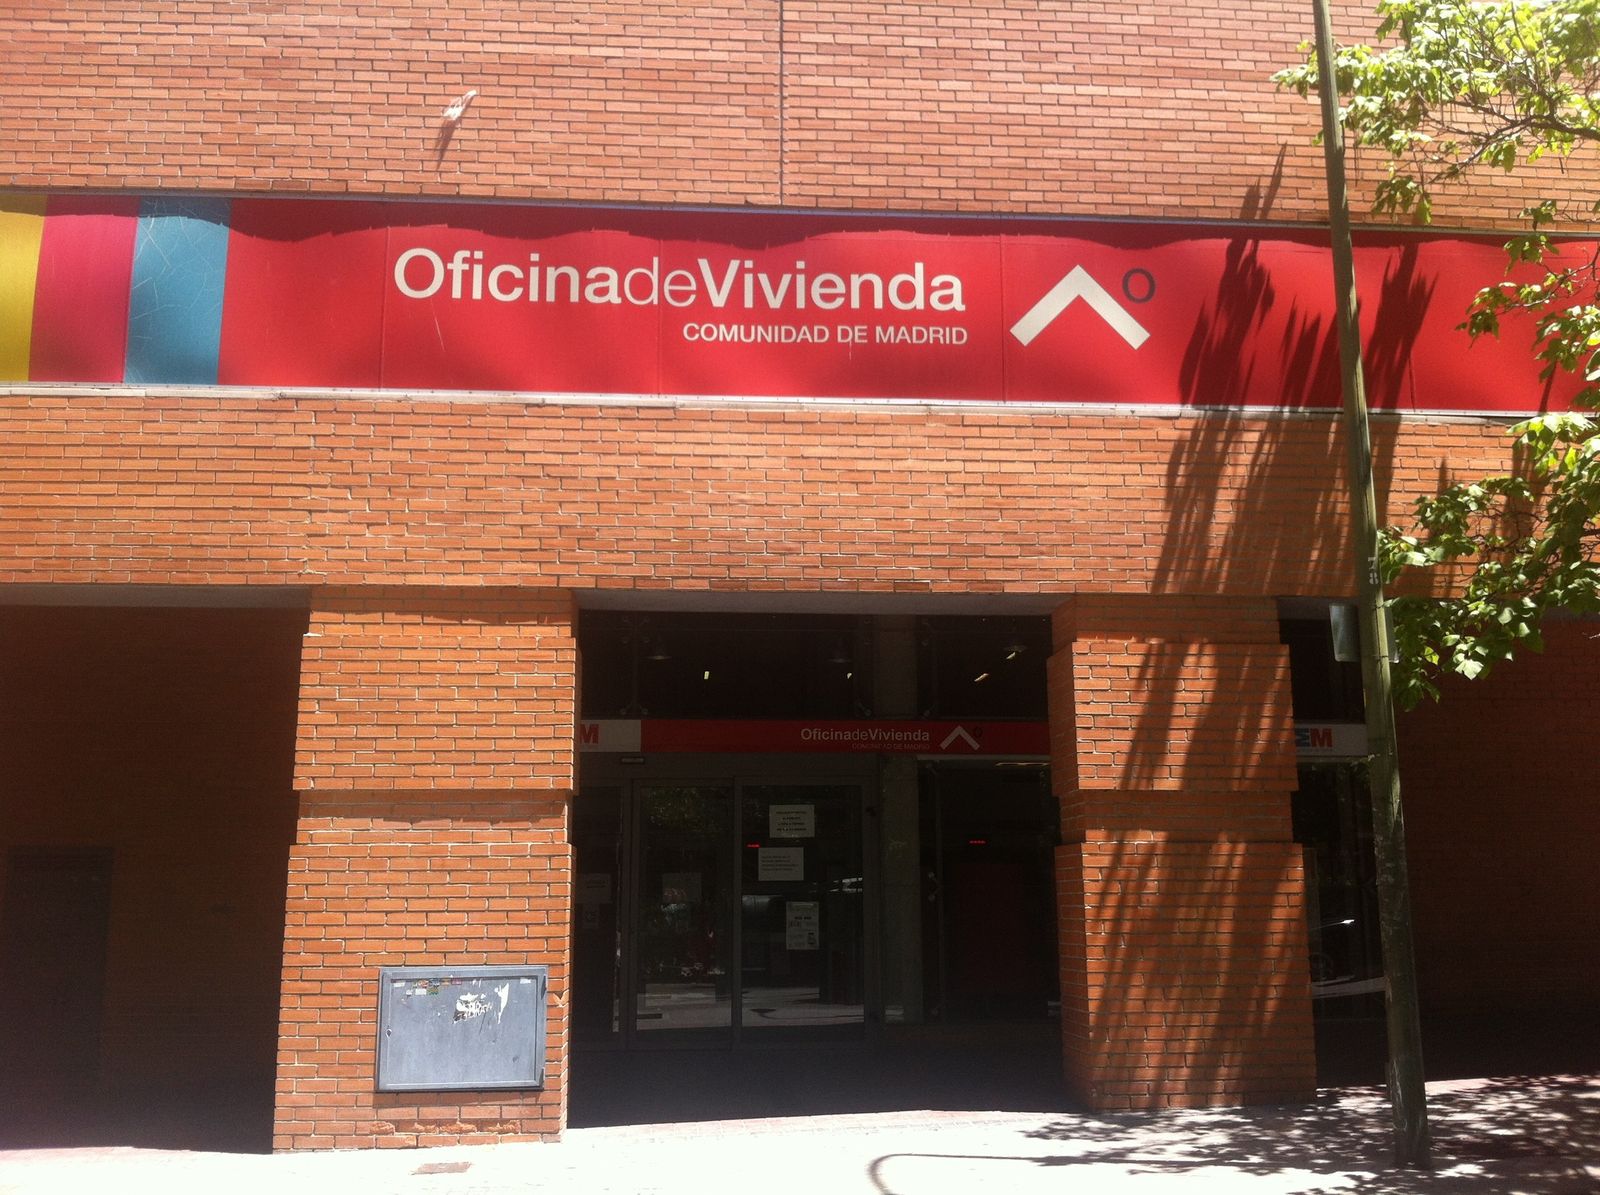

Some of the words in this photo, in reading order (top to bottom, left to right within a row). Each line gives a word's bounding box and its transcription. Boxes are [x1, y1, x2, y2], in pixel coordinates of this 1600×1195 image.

[394, 248, 966, 312] OficinadeVivienda
[682, 322, 830, 344] COMUNIDAD
[836, 324, 869, 345] DE
[875, 325, 968, 346] MADRID
